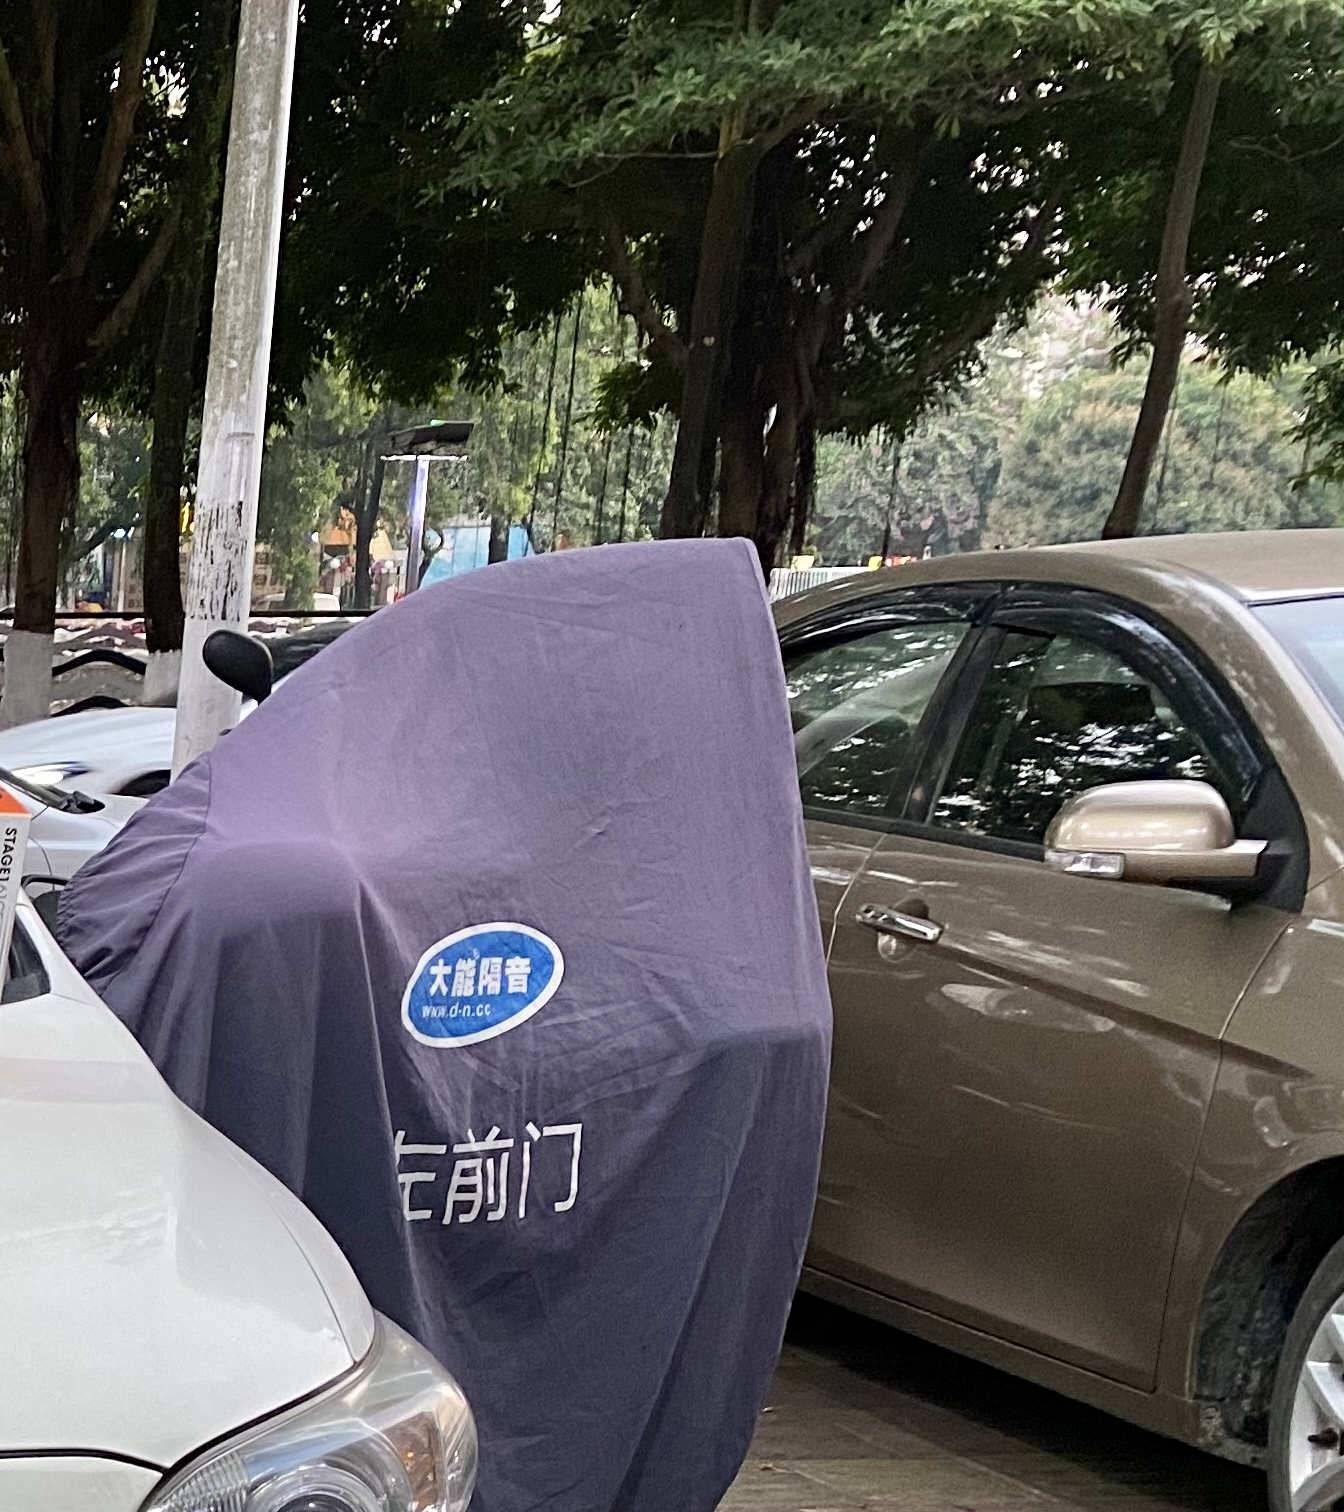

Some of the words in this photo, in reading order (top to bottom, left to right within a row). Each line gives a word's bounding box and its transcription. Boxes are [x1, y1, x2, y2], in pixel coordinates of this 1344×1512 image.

[429, 955, 532, 997] 大能隔音
[393, 1121, 583, 1226] 左前门
